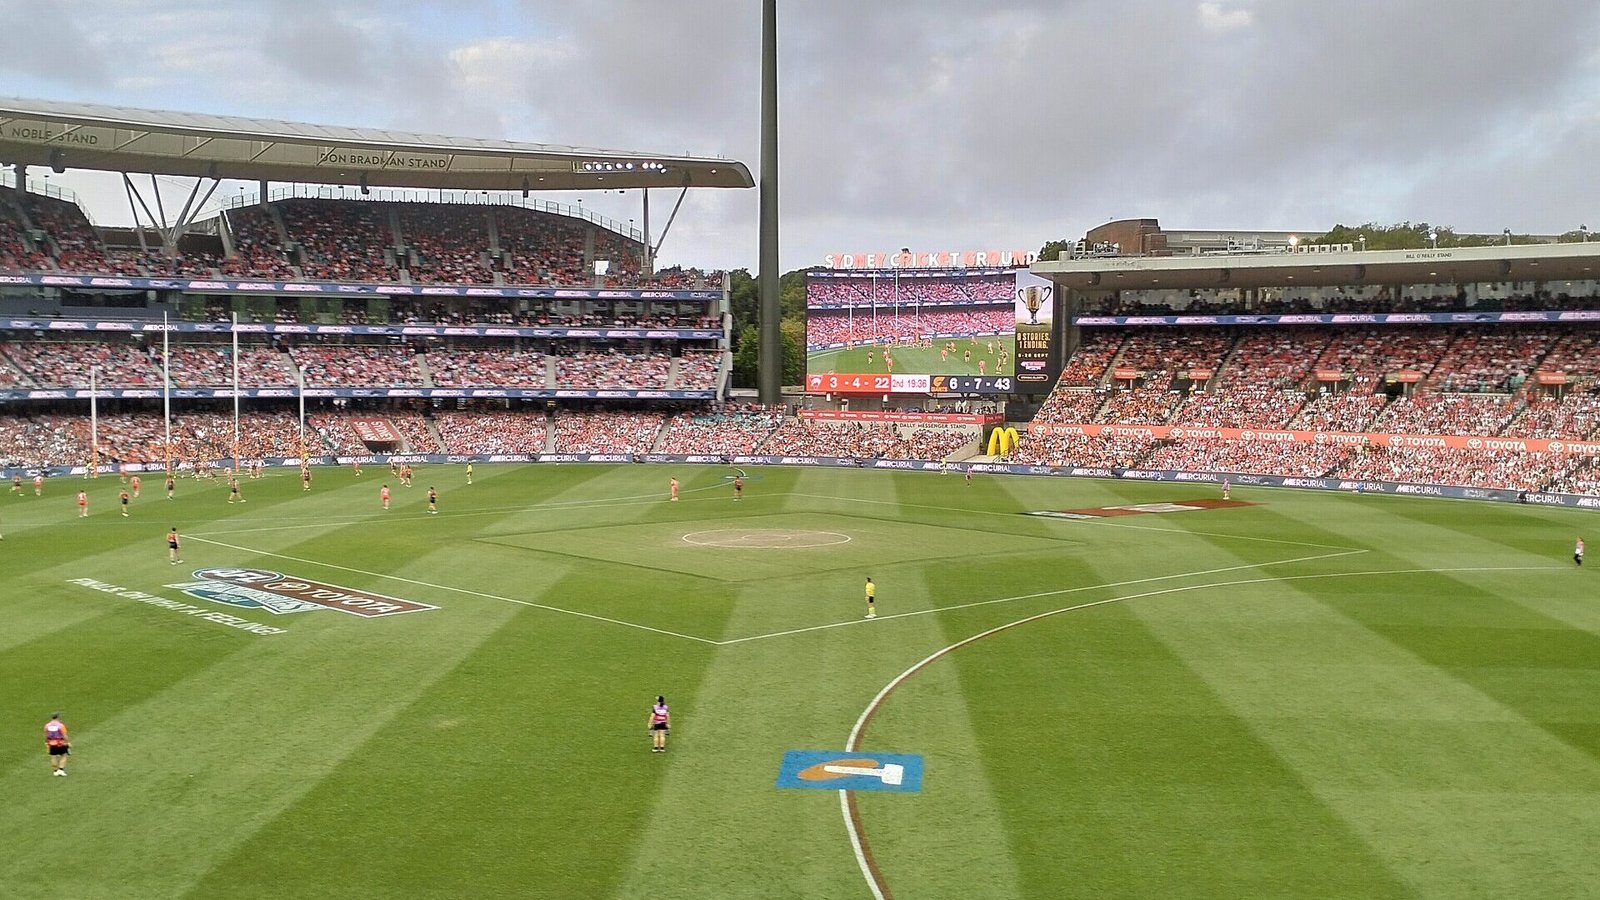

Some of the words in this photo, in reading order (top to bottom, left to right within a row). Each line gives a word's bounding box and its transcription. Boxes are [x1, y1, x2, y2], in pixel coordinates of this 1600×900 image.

[12, 128, 52, 140] NOBLE
[58, 132, 98, 145] STAND
[320, 153, 347, 163] DON
[350, 153, 405, 166] BRADMAN
[408, 158, 446, 168] STAND
[824, 252, 886, 268] SYDNEY
[890, 251, 960, 267] CRICKET
[963, 250, 1038, 267] GROUND
[829, 377, 837, 388] 3
[852, 377, 861, 388] 4
[874, 377, 889, 388] 22
[892, 378, 904, 388] 2nd
[907, 378, 927, 388] 19:36
[949, 377, 958, 388] 6
[973, 378, 982, 388] 7
[994, 378, 1011, 389] 43
[1186, 429, 1223, 438] TOYOTA
[1257, 431, 1296, 441] TOYOTA
[1406, 437, 1447, 447] TOYOTA
[1484, 440, 1527, 450] TOYOTA
[488, 454, 529, 462] MERCURIAL
[538, 454, 580, 462] MERCURIAL
[588, 454, 628, 462] MERCURIAL
[781, 456, 819, 464] MERCURIAL
[874, 460, 913, 469] MERCURIAL
[1071, 467, 1112, 477] MERCURIAL
[1175, 472, 1218, 482] MERCURIAL
[1282, 477, 1328, 488] MERCURIAL
[1338, 481, 1385, 492] MERURIAL
[1395, 485, 1443, 495] MERCURIAL
[1526, 493, 1565, 504] ERCURIAL
[301, 589, 404, 613] TOYOTA
[194, 612, 288, 635] FEELING!
